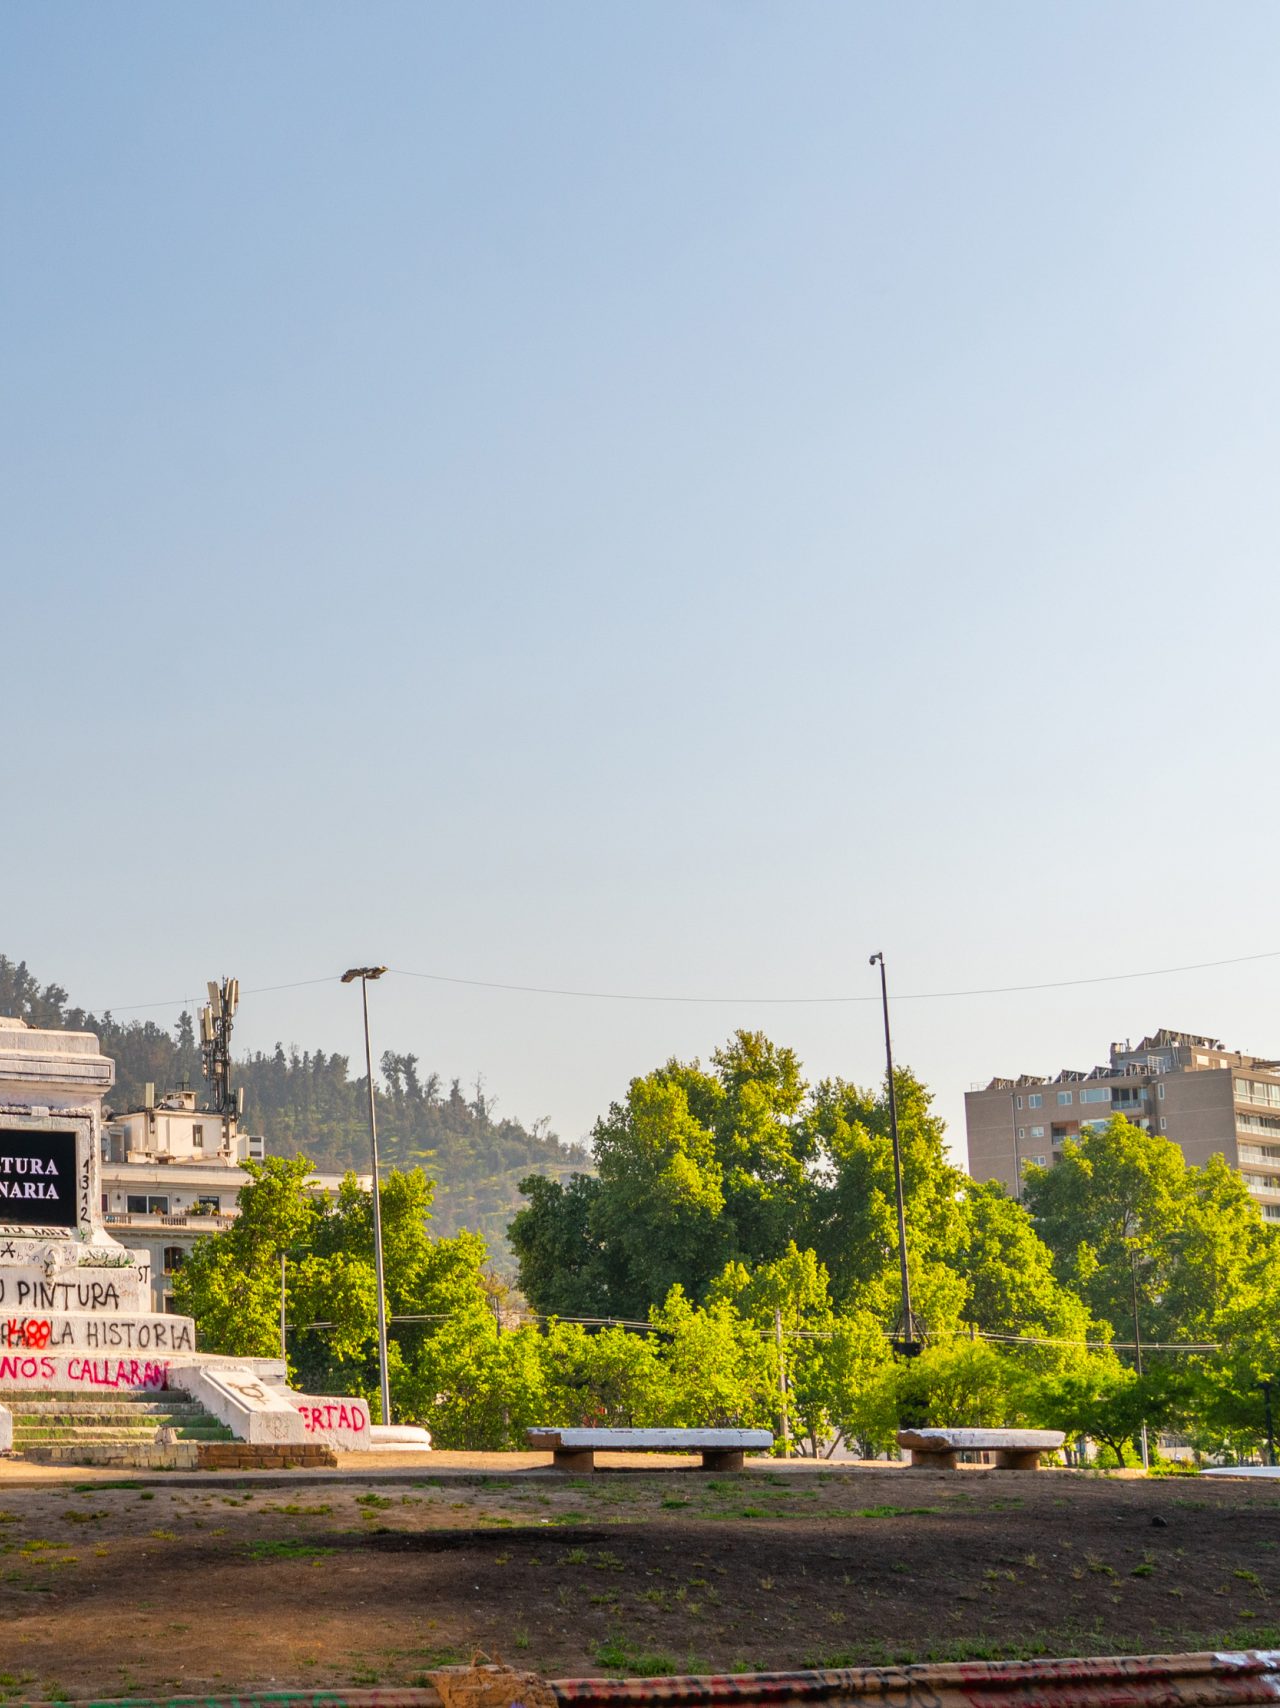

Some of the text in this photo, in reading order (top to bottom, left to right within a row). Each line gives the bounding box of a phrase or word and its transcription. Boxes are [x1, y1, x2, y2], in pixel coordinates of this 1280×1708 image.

[80, 1159, 91, 1223] 1312
[17, 1280, 120, 1311] PINTURA
[50, 1320, 74, 1345] LA
[87, 1320, 193, 1351] HISTORIA
